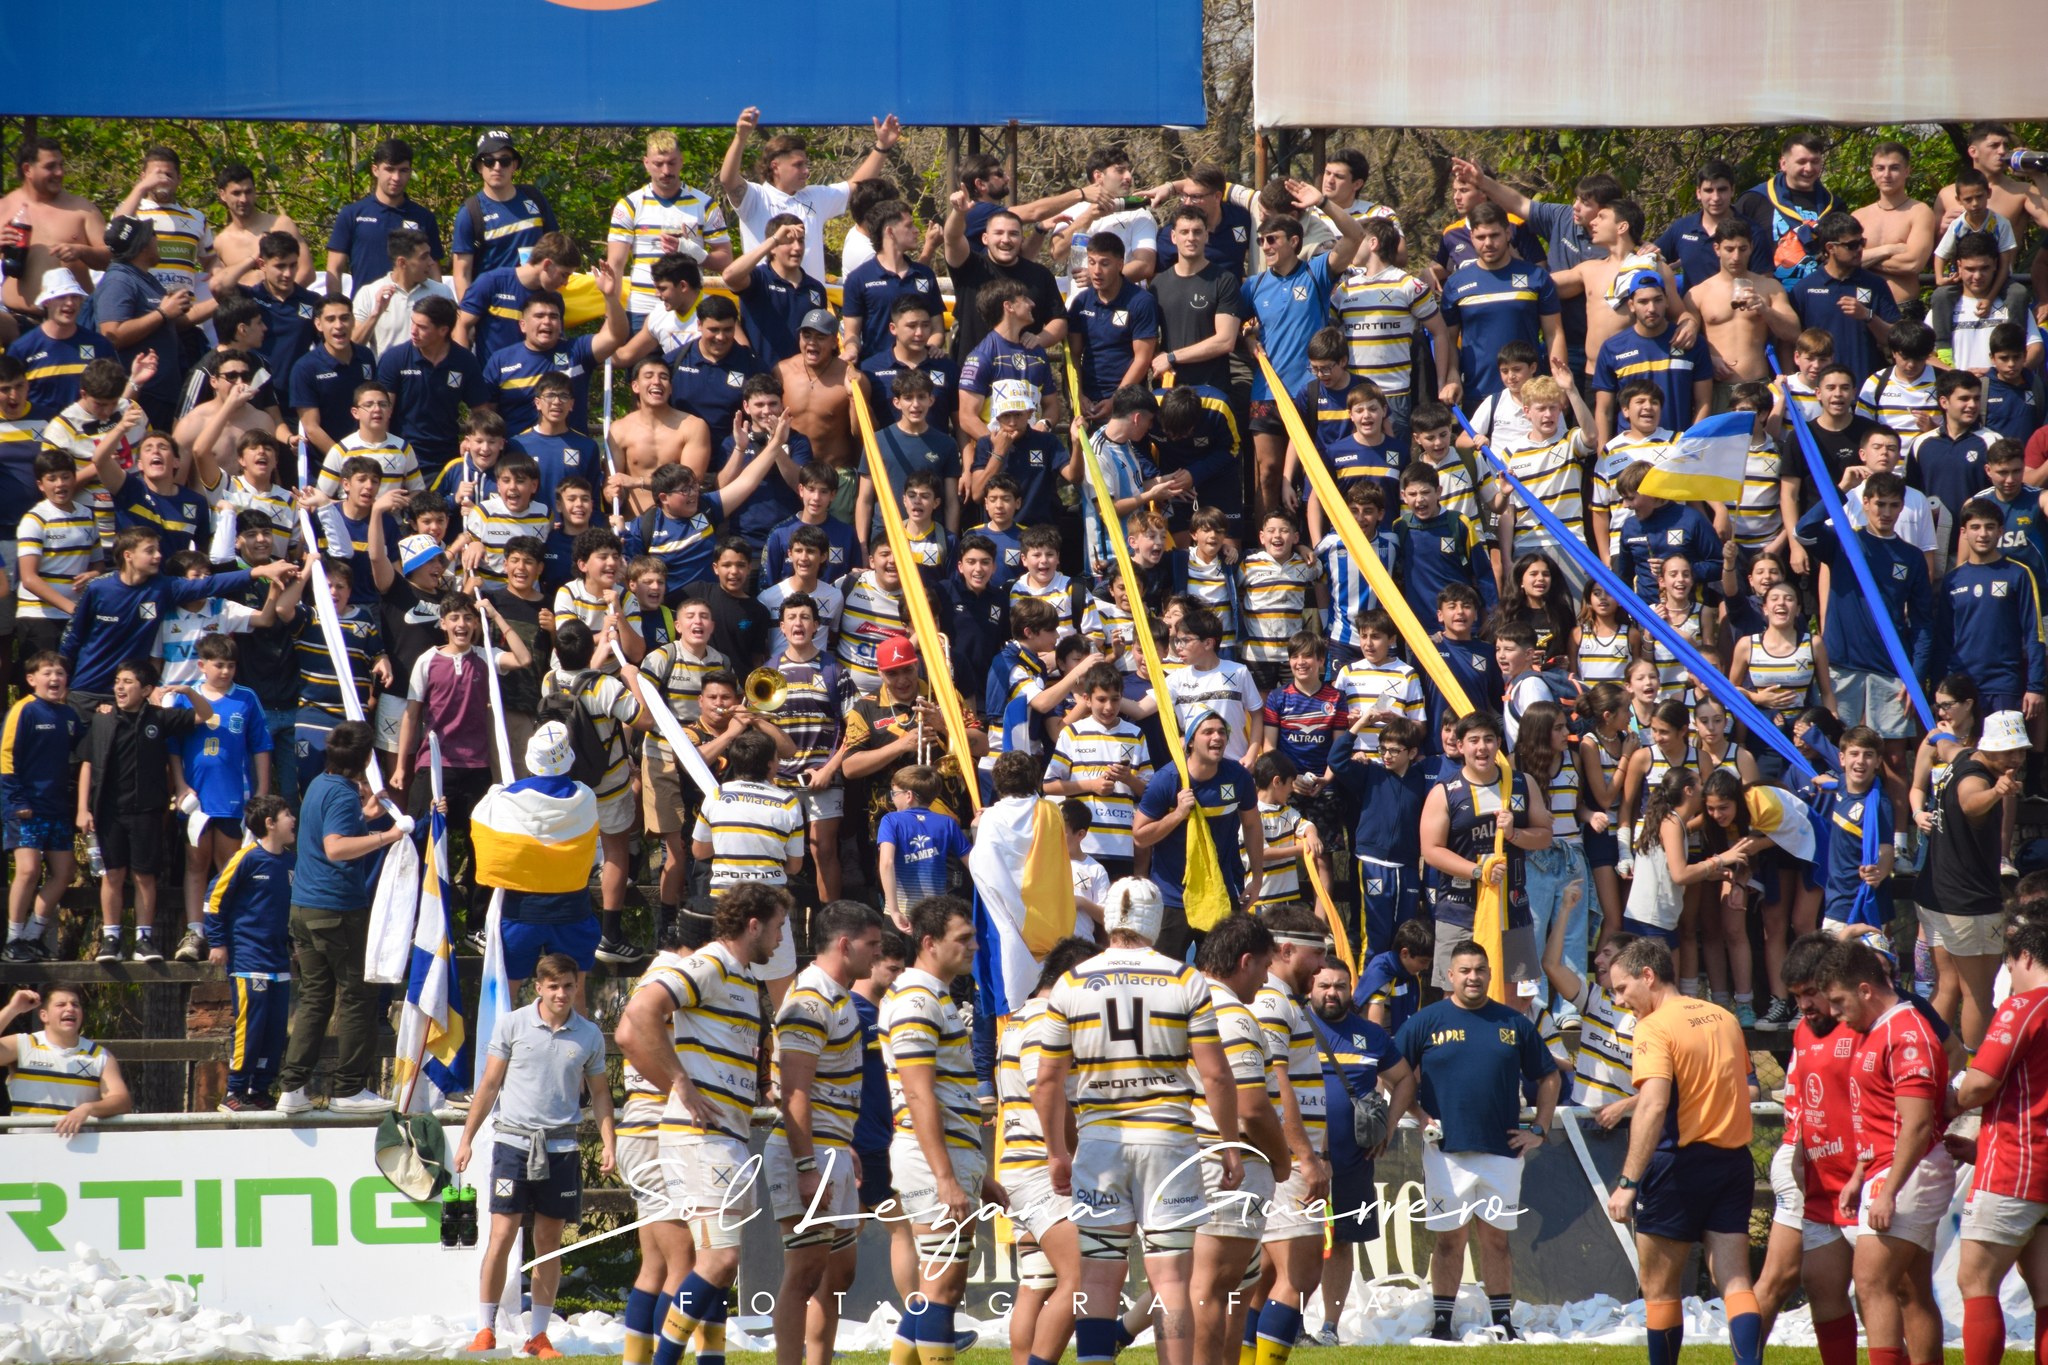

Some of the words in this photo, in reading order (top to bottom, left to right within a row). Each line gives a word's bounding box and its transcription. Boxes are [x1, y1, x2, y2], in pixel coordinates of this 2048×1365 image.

[1335, 455, 1357, 463] PROCER
[1997, 530, 2028, 548] ISA
[854, 593, 875, 602] PROCER
[1288, 734, 1325, 743] ALTRAD
[203, 737, 219, 756] 10
[743, 794, 782, 809] Macro
[1472, 820, 1495, 841] PAL
[904, 847, 939, 863] PAMPA
[713, 870, 783, 880] SPORTING
[1114, 974, 1167, 987] Macro
[1106, 996, 1145, 1056] 4
[1688, 1014, 1723, 1027] DIRECTV
[1588, 1032, 1633, 1060] SPORTI
[1088, 1074, 1178, 1090] SPORTING
[1301, 1096, 1318, 1106] LA
[902, 1187, 935, 1199] NGREEN
